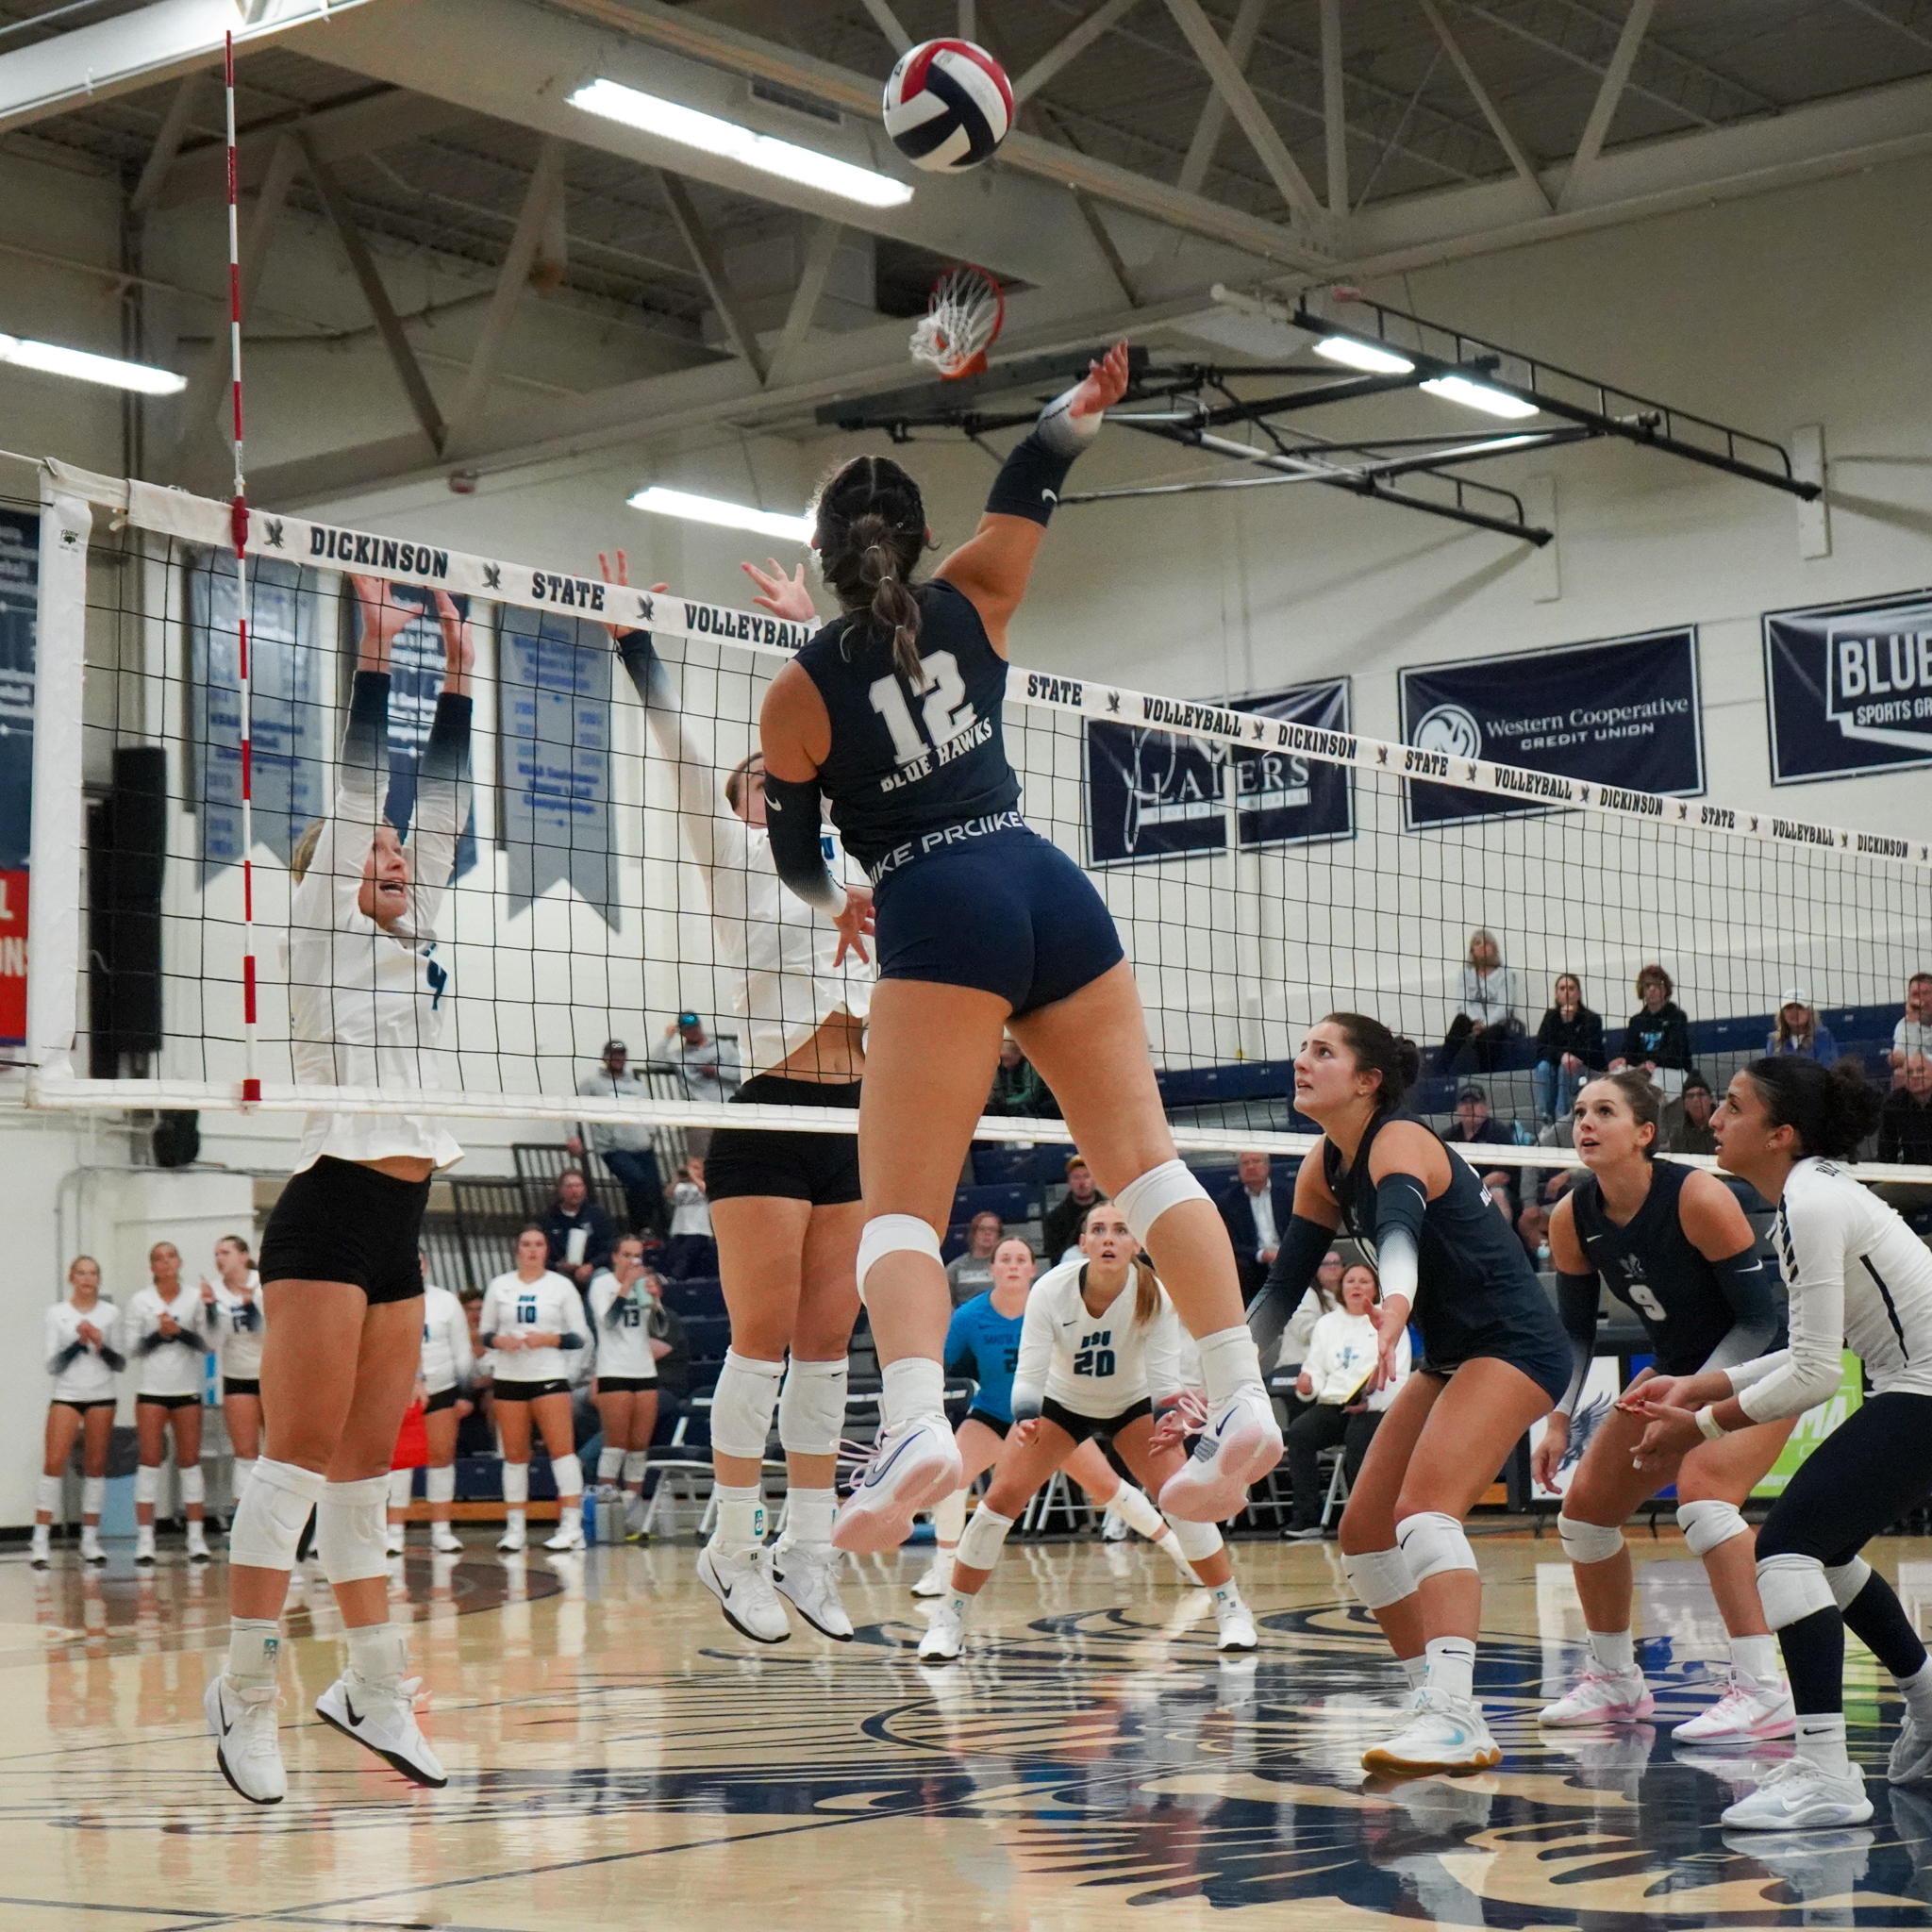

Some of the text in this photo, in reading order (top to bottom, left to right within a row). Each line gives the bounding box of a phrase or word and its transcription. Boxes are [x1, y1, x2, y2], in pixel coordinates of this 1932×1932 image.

[1840, 630, 1932, 698] BLUE
[310, 526, 448, 578] DICKINSON
[532, 571, 605, 612] STATE
[1027, 674, 1083, 707] STATE
[1142, 696, 1241, 738] VOLLEYBALL
[1277, 724, 1357, 760] DICKINSON
[1405, 749, 1449, 776] STATE
[1494, 767, 1573, 800] VOLLEYBALL
[1600, 787, 1663, 816] DICKINSON
[1701, 806, 1735, 829] STATE
[1773, 819, 1834, 847] VOLLEYBALL
[1857, 834, 1908, 858] DICKINSON
[869, 649, 977, 765] 12
[1486, 697, 1689, 738] Western Cooperative
[1857, 699, 1911, 726] SPORTS
[880, 717, 992, 792] BLUE HAWKS
[1521, 722, 1655, 751] CREDIT UNION
[517, 1305, 536, 1324] 10
[1628, 1284, 1667, 1321] 9
[1074, 1349, 1115, 1377] 20
